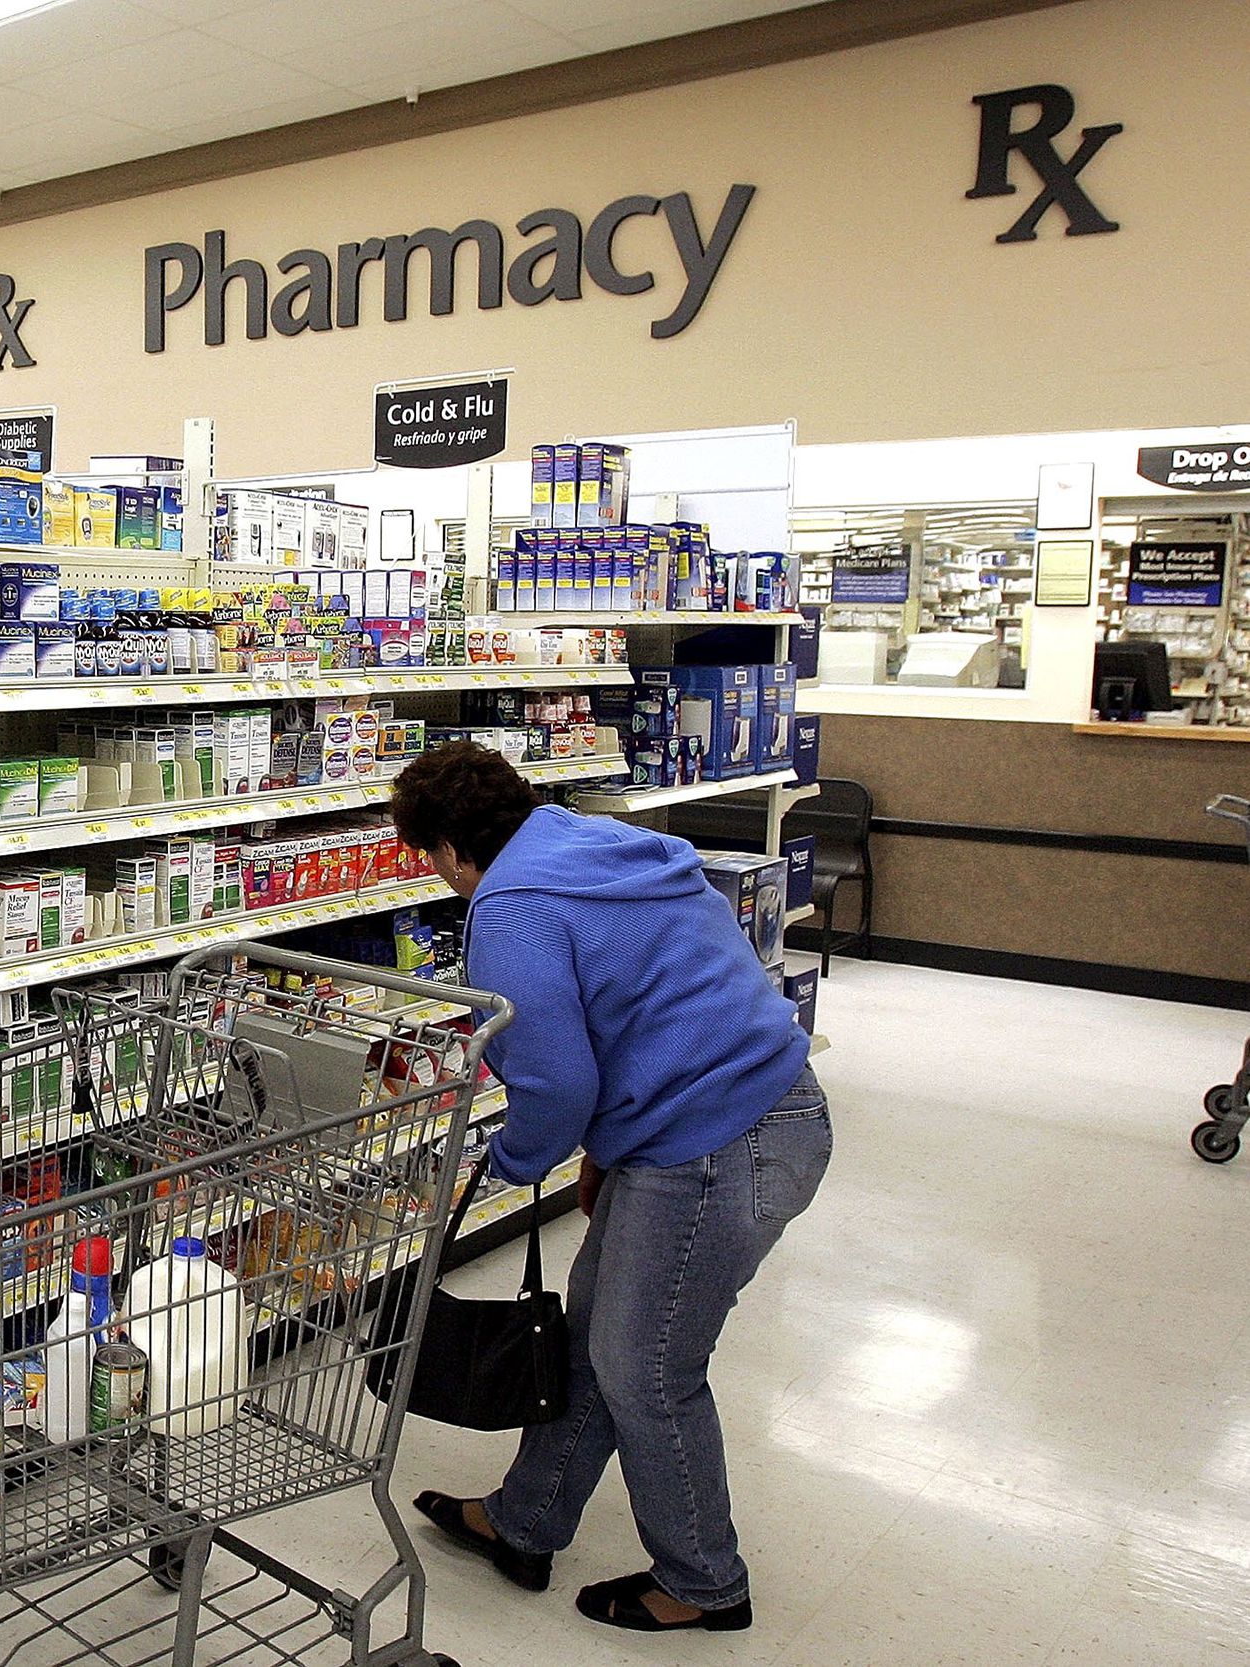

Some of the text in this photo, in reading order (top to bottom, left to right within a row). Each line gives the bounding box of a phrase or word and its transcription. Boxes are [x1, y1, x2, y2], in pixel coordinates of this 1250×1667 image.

[144, 181, 756, 354] Pharmacy
[387, 395, 494, 427] Cold & Flu
[393, 425, 487, 448] Resfriado y gripe
[1173, 449, 1228, 471] Drop
[1139, 550, 1215, 562] We Accept
[836, 558, 907, 568] Medicare Plans
[22, 567, 59, 579] Mucinex
[1132, 572, 1192, 583] Prescription
[38, 627, 73, 637] Mucinex
[8, 894, 30, 903] Mucus
[7, 902, 27, 912] Relief
